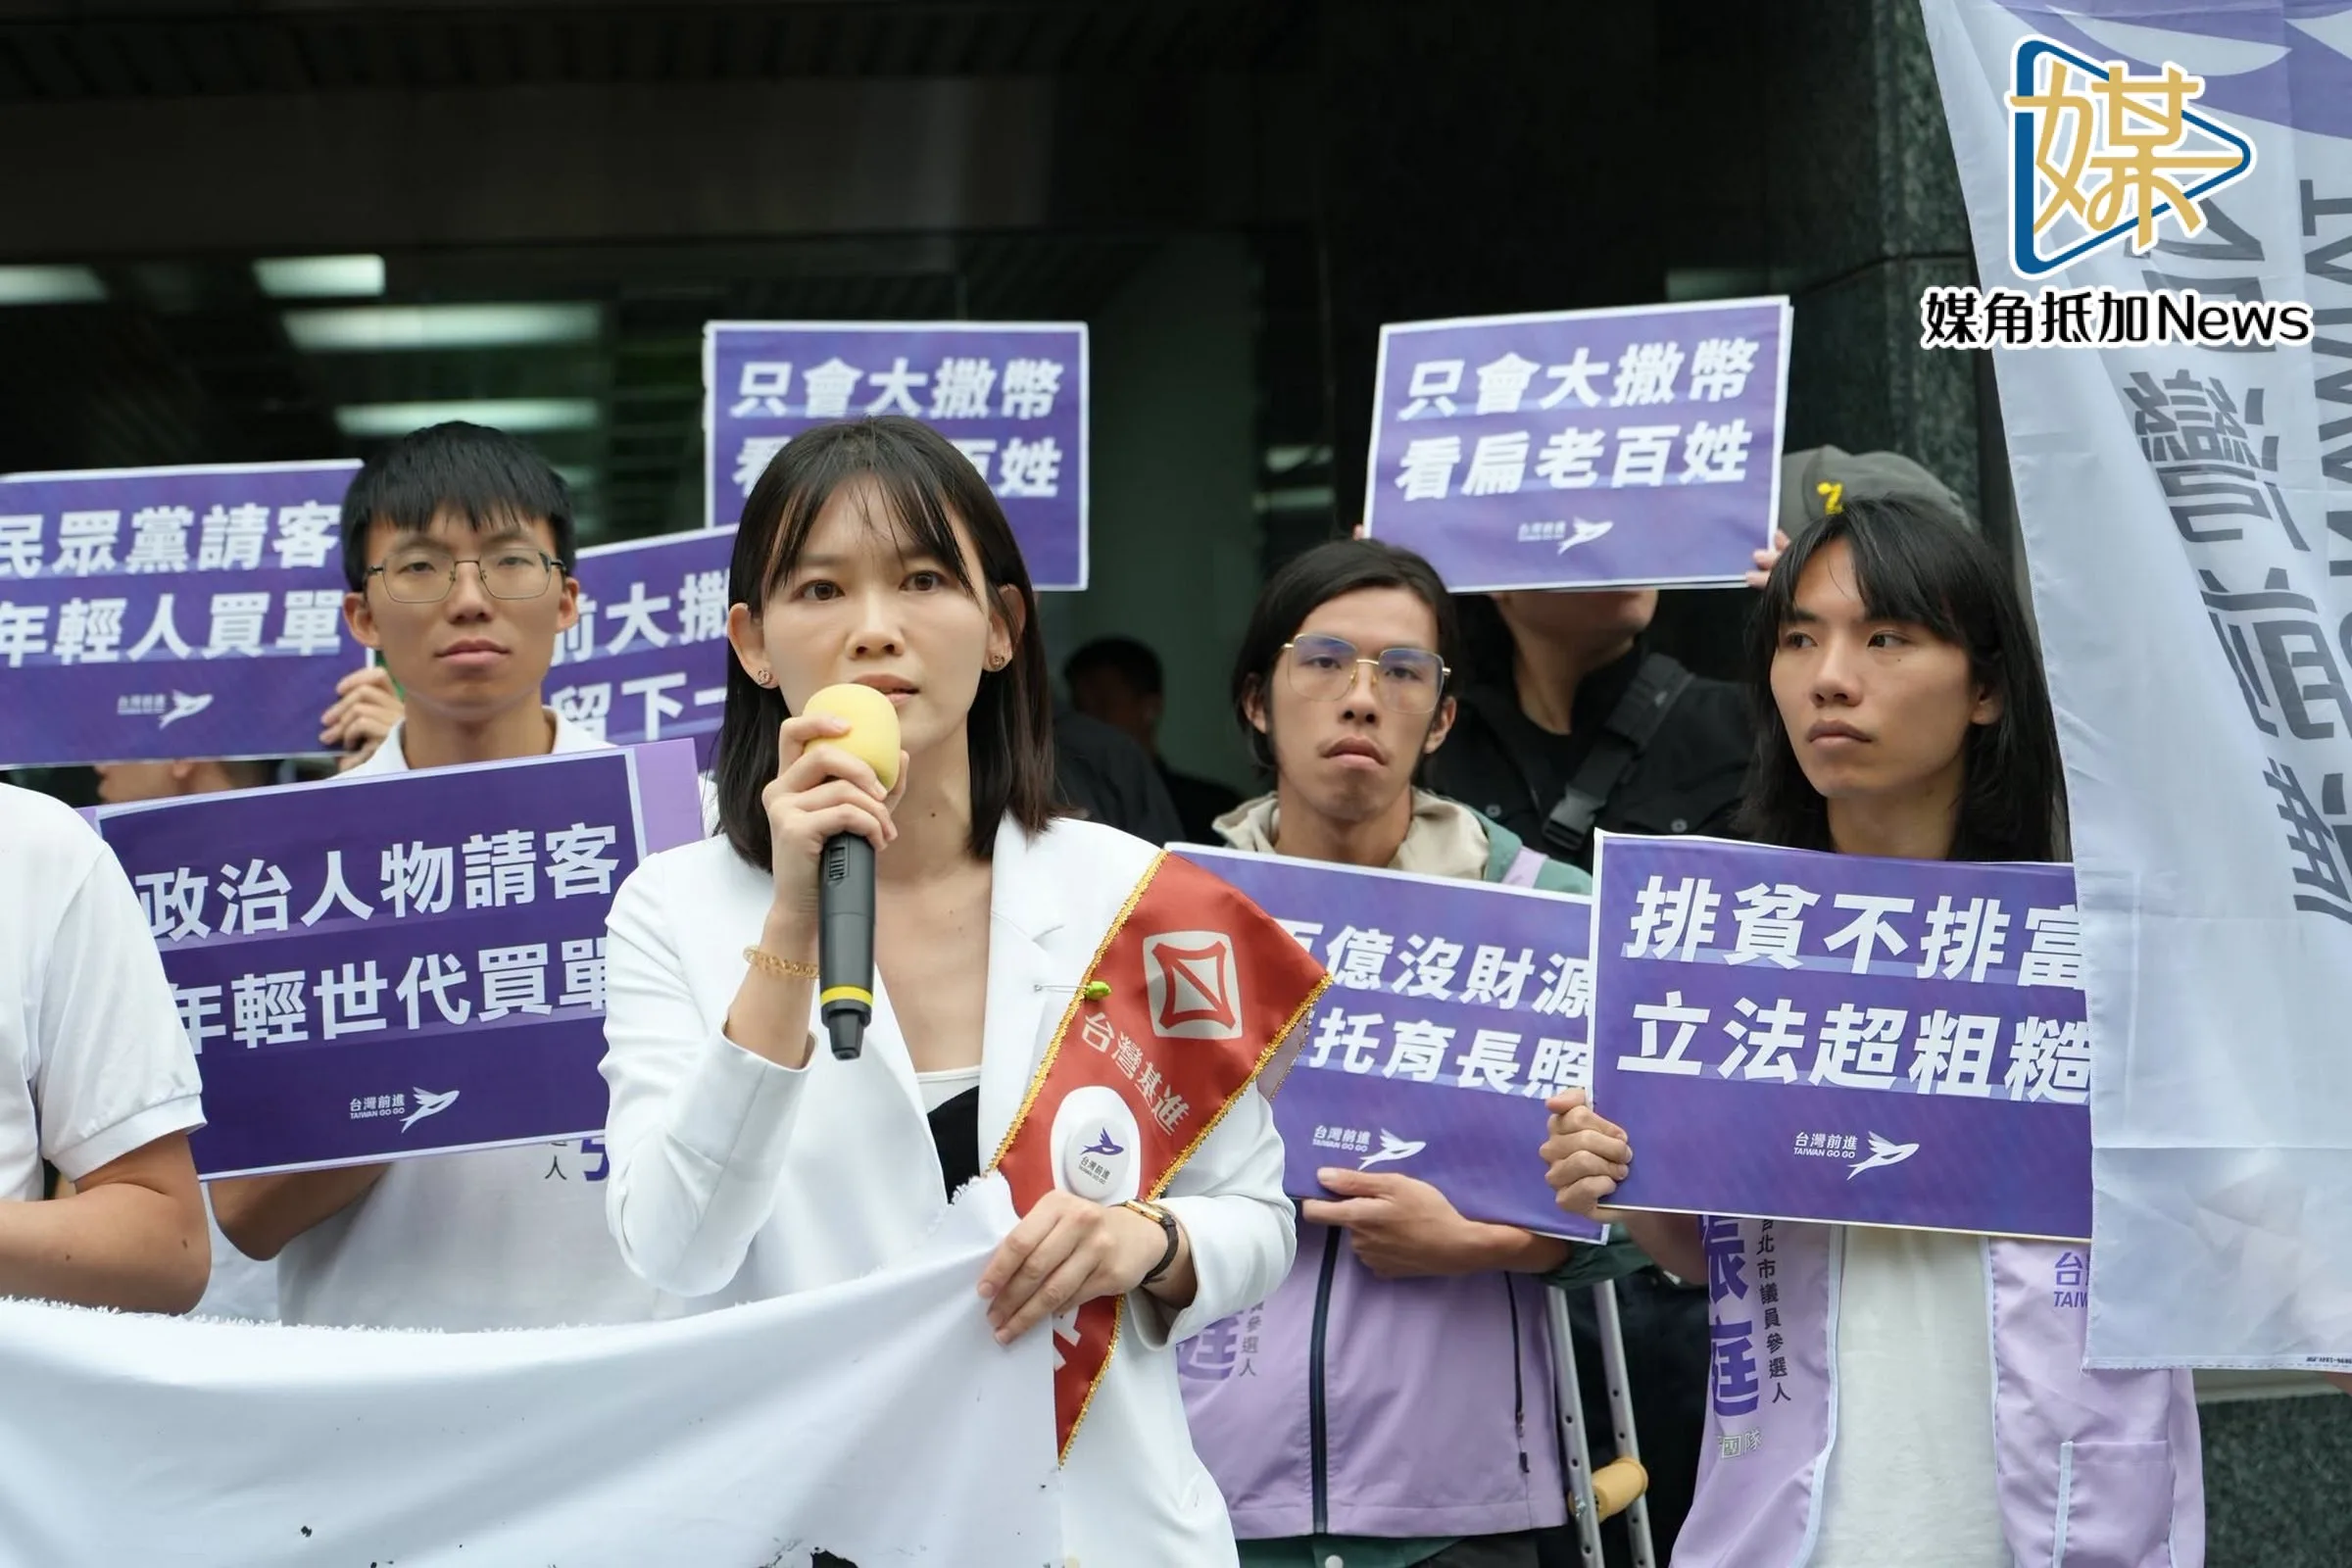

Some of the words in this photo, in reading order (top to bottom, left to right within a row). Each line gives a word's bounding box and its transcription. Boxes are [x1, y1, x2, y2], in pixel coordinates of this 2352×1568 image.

[730, 357, 1063, 419] 只會大撒幣
[1396, 337, 1759, 421] 只會大撒幣
[1395, 418, 1753, 502] 看扁老百姓
[0, 500, 341, 579] 民眾黨請客
[0, 588, 344, 668] 年輕人買單
[135, 822, 620, 943] 政治人物請客
[1627, 874, 2083, 991] 排貧不排富
[169, 937, 608, 1055] 年輕世代買單
[1081, 1011, 1190, 1137] 台灣基進
[1617, 990, 2091, 1103] 立法超粗糙
[350, 1093, 405, 1112] 台灣前進
[350, 1110, 378, 1120] TAIWAN
[379, 1107, 392, 1116] GO
[392, 1106, 406, 1115] GO
[1795, 1131, 1858, 1152] 台灣前進
[1793, 1147, 1825, 1157] TAIWAN
[1826, 1150, 1840, 1158] GO
[1841, 1151, 1856, 1159] GO
